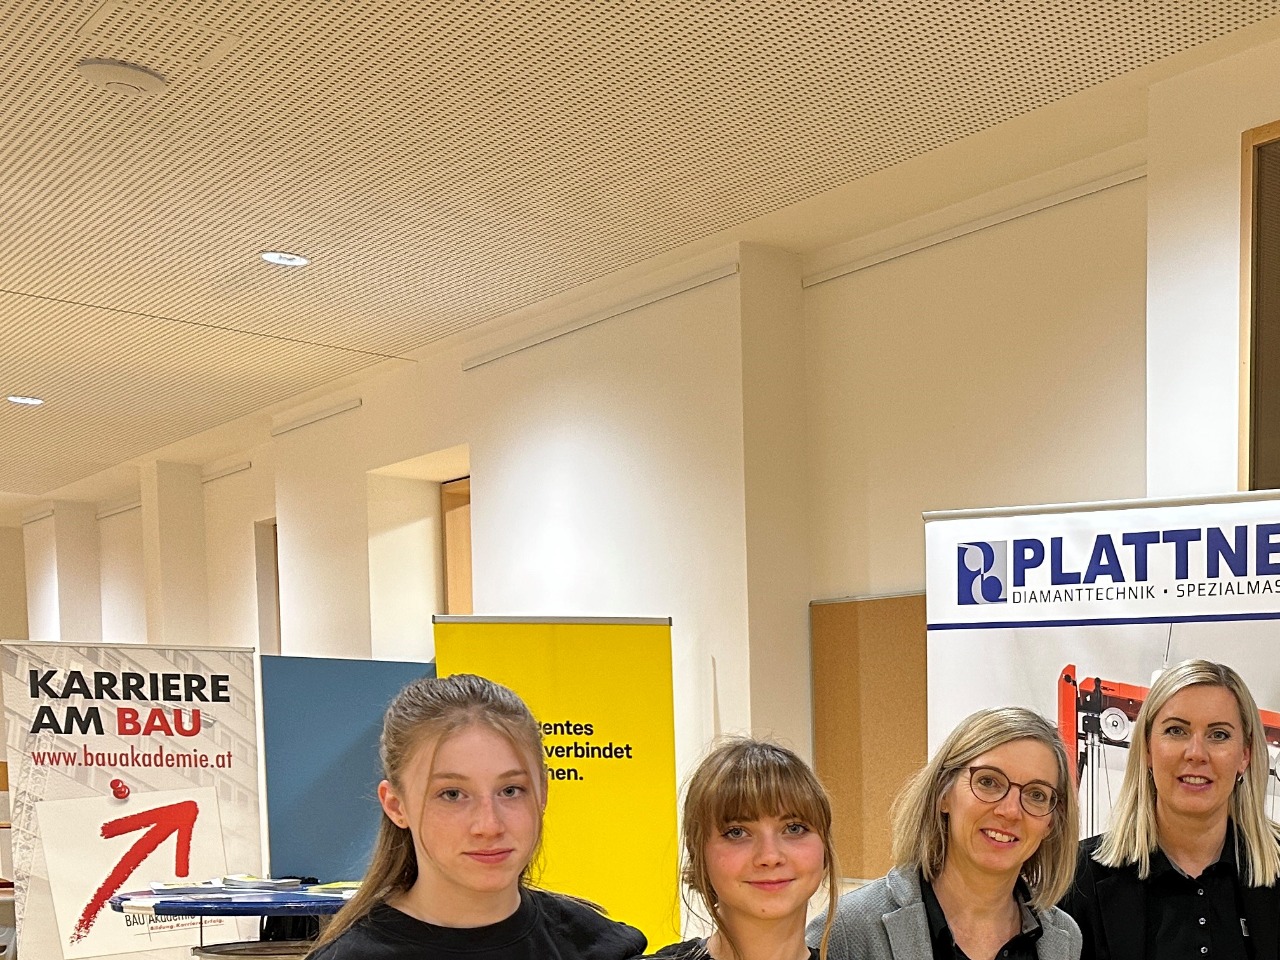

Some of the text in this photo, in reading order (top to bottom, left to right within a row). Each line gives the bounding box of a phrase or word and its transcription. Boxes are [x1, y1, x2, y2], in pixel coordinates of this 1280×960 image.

[1012, 585, 1155, 604] DIAMANTTECHNIK
[29, 669, 230, 703] KARRIERE
[30, 705, 201, 737] AM BAU
[539, 720, 594, 739] entes
[31, 744, 233, 769] www.bauakademie.at
[544, 741, 633, 759] verbindet
[125, 914, 145, 927] BAU
